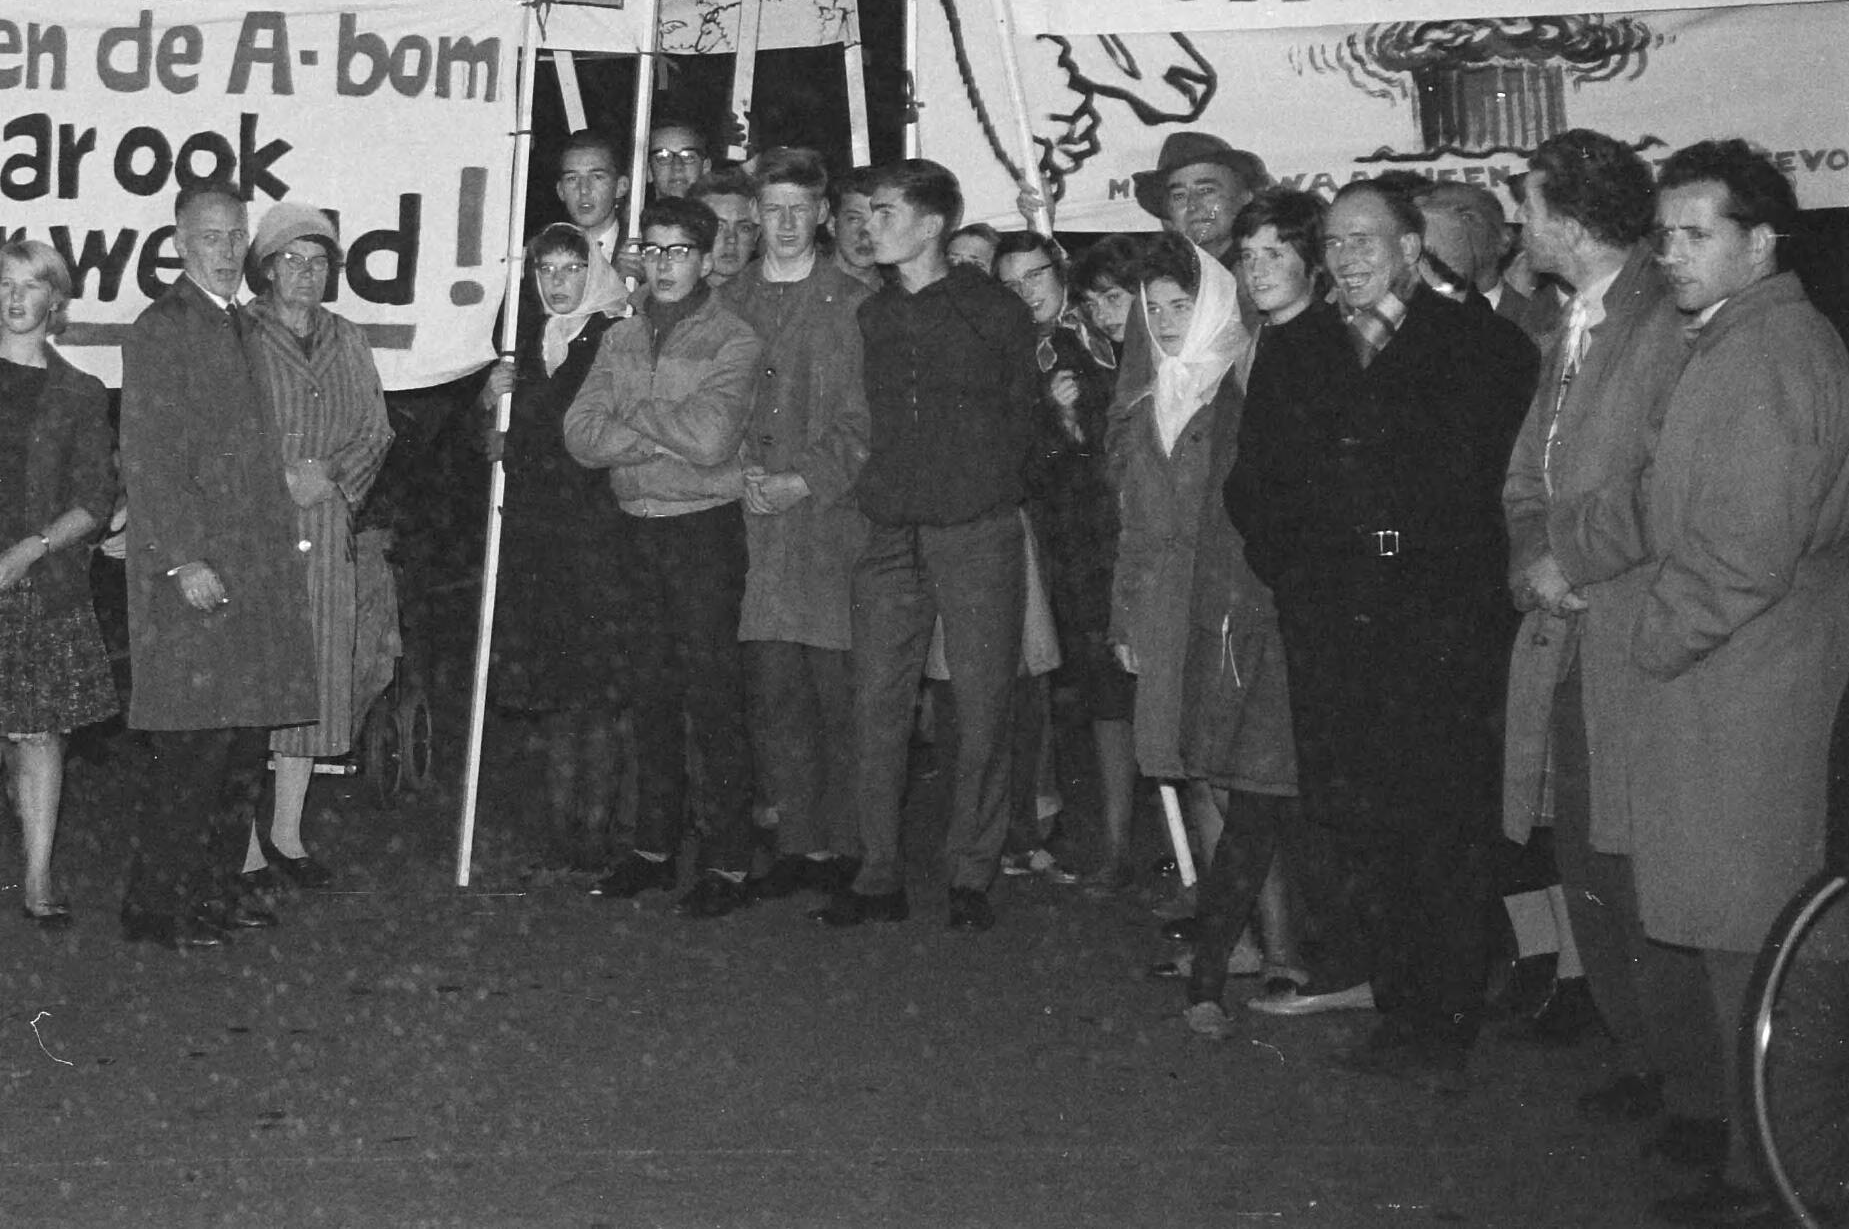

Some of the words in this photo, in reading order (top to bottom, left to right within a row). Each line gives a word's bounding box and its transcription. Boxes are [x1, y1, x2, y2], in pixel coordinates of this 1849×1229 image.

[96, 10, 204, 93] de
[226, 11, 501, 103] A-bom
[113, 113, 294, 202] ook
